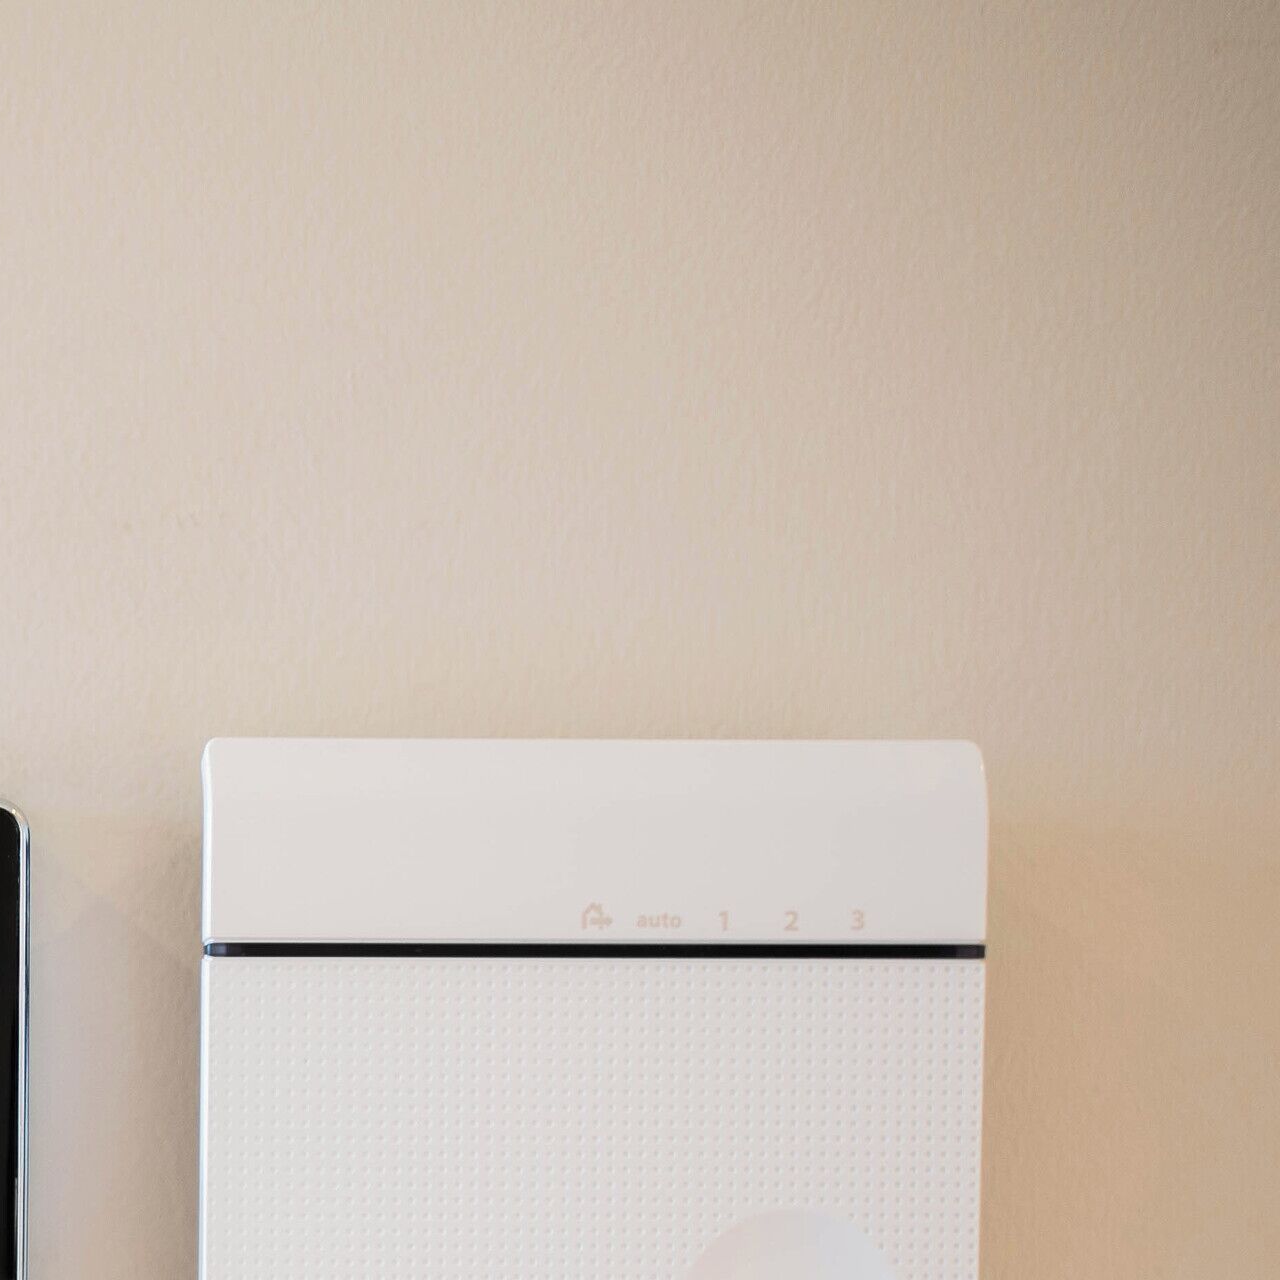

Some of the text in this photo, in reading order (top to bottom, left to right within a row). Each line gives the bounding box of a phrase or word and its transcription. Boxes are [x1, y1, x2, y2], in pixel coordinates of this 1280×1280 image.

[636, 909, 866, 932] auto 1 2 3
